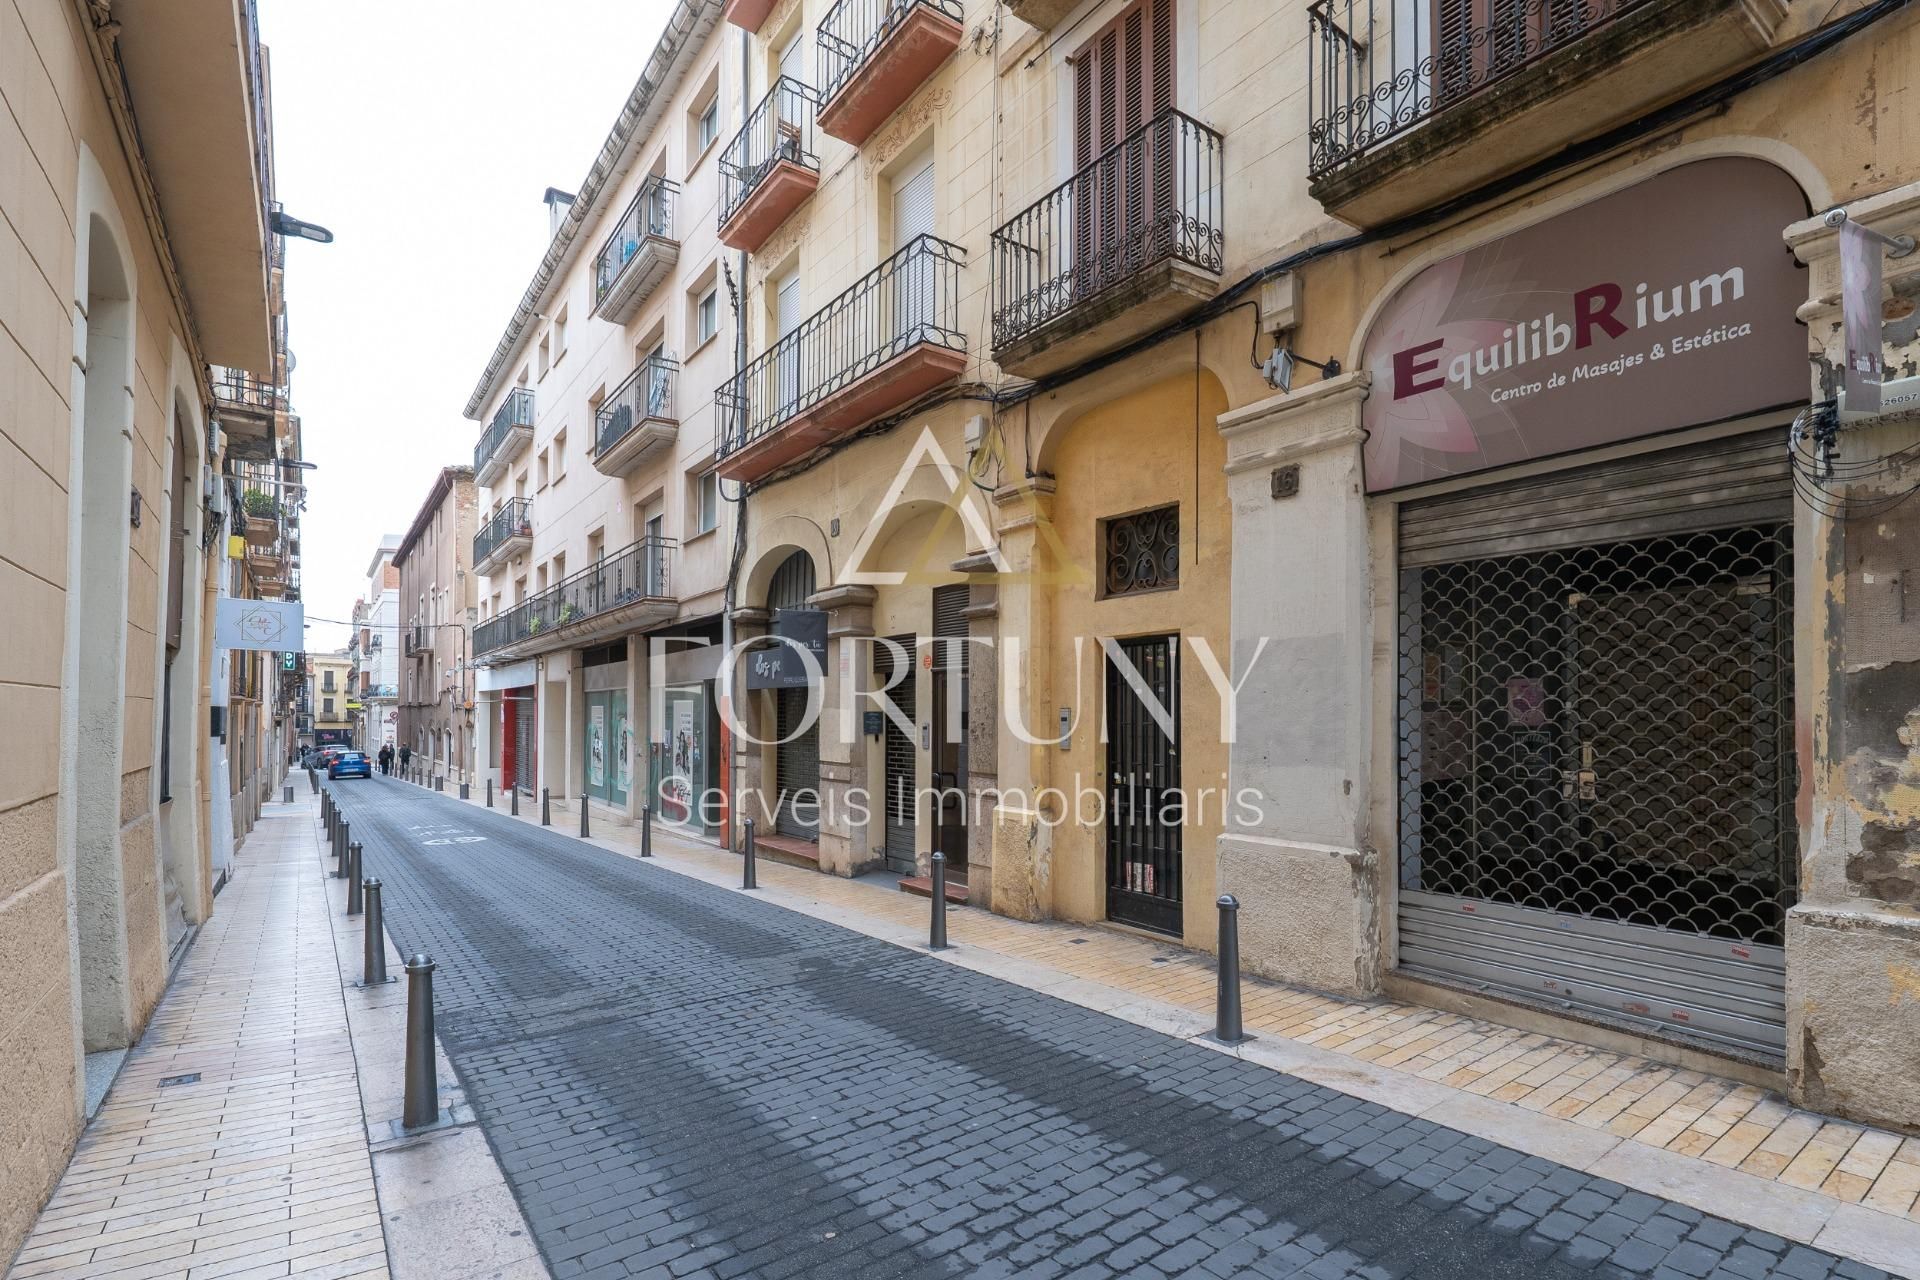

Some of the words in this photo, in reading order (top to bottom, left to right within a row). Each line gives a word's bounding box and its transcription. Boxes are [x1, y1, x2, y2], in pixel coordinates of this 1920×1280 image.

[1393, 266, 1745, 401] EquilibRium
[1490, 380, 1542, 403] Centro
[1547, 372, 1566, 389] de
[1572, 352, 1644, 383] Masajes
[1650, 343, 1665, 361] &
[1672, 323, 1752, 355] Estética
